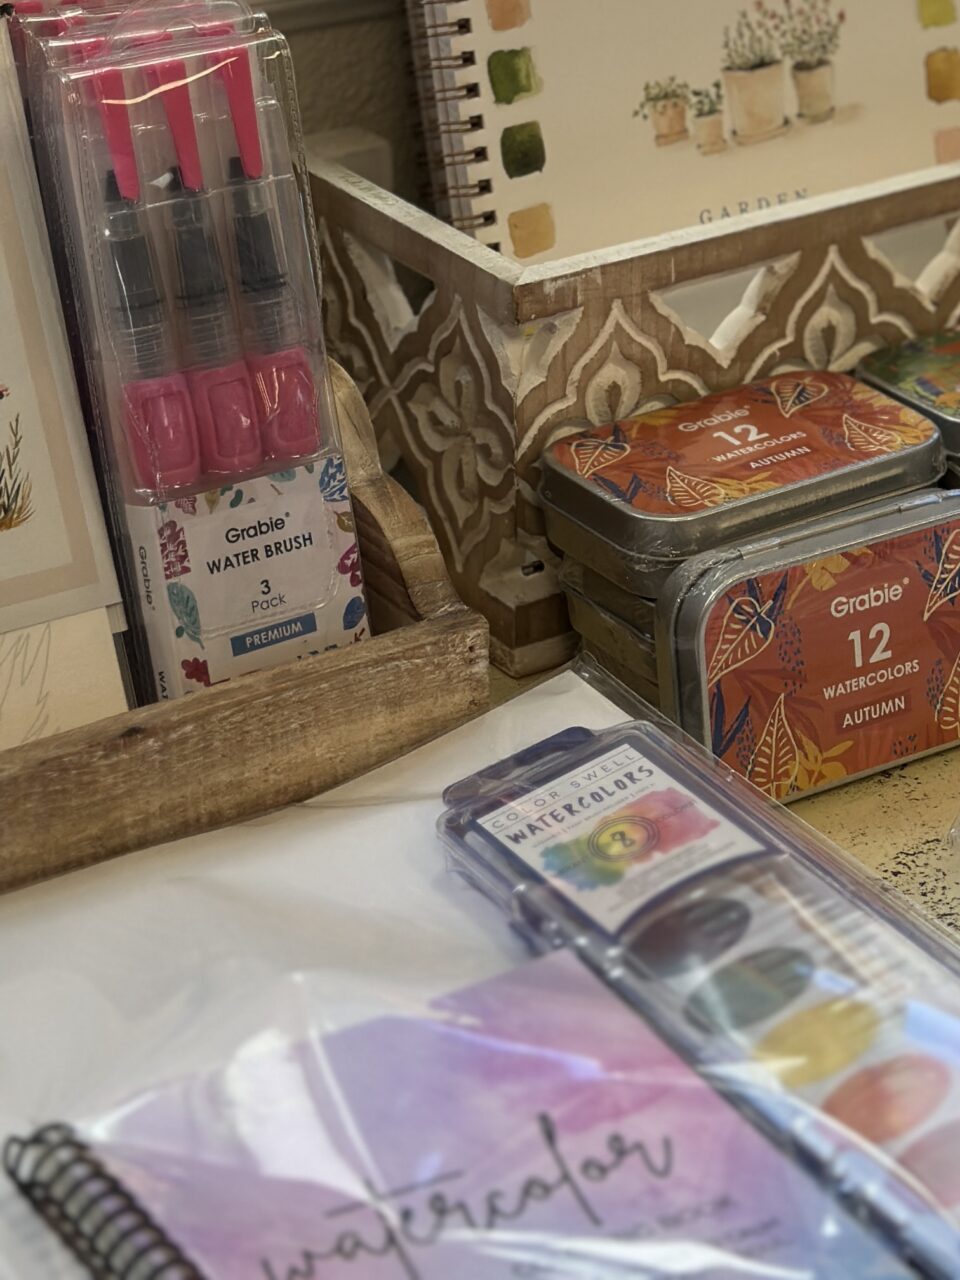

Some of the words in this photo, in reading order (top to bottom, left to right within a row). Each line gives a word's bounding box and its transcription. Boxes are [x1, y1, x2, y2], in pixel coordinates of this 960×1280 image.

[699, 189, 808, 225] GARDEN
[678, 407, 750, 432] Grabie
[712, 431, 807, 463] WATERCOLORS
[713, 424, 770, 446] 12
[750, 446, 812, 469] AUTUMN
[225, 516, 286, 544] Grabie
[206, 548, 261, 575] WATER
[264, 531, 314, 559] BRUSH
[260, 579, 272, 595] 3
[830, 583, 903, 618] Grabie
[251, 593, 288, 613] Pack
[245, 621, 303, 648] PREMIUM
[848, 622, 893, 669] 12
[158, 671, 169, 700] WAT
[823, 659, 921, 700] WATERCOLORS
[842, 695, 906, 729] AUTUMN
[492, 790, 561, 829] COLOR
[570, 753, 636, 789] SWELL
[505, 764, 655, 845] WATERCOLORS
[608, 830, 635, 848] 8
